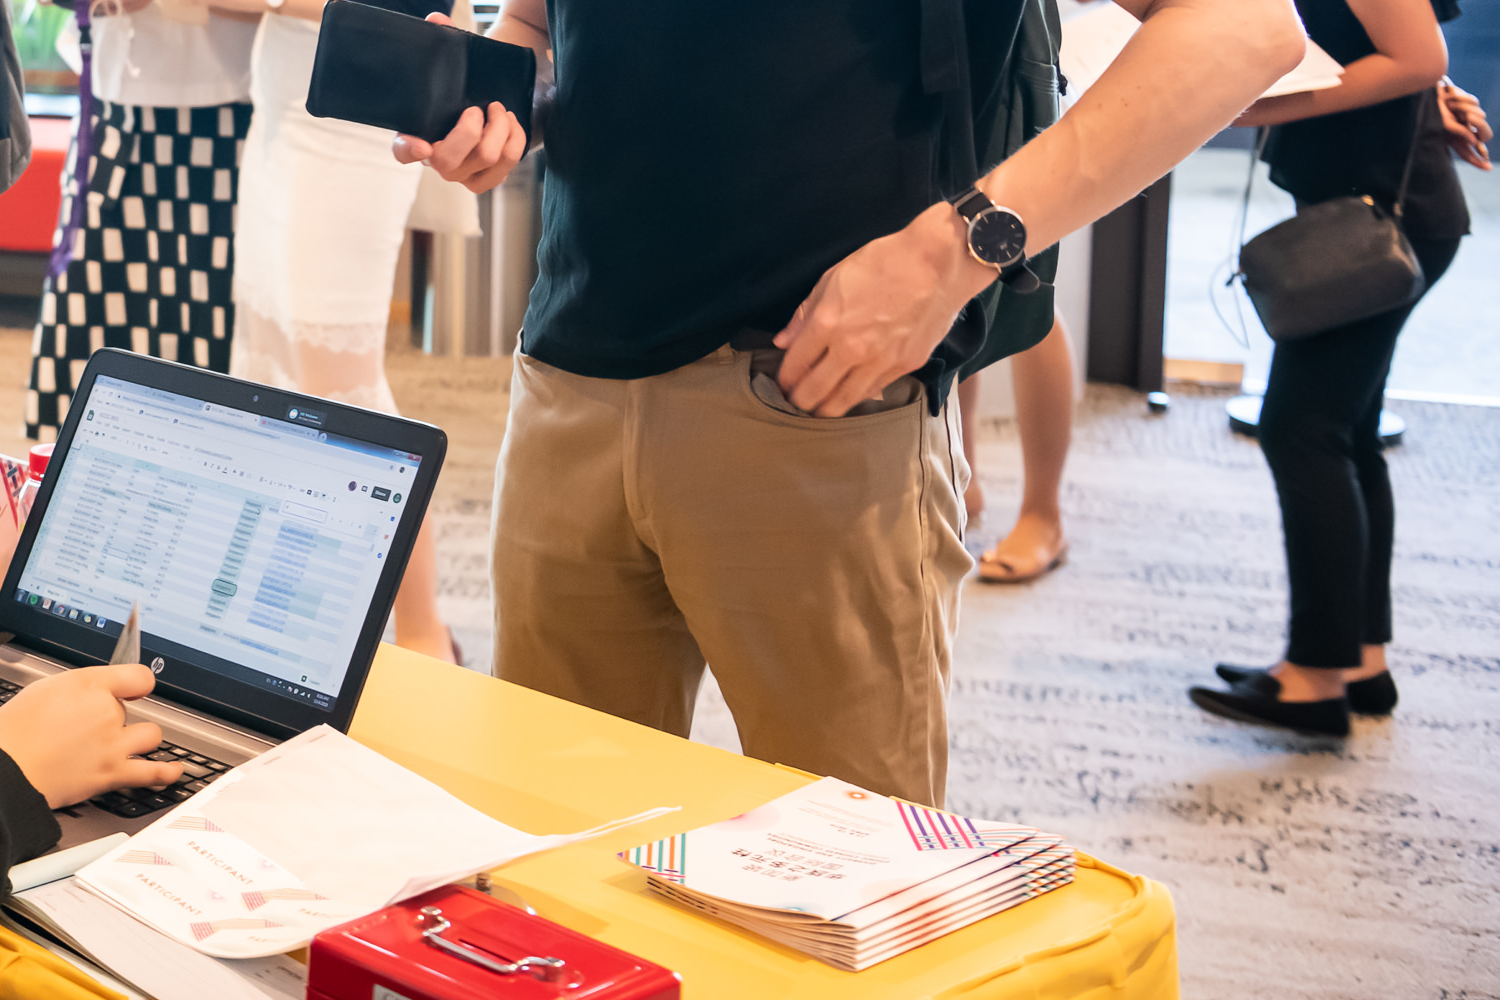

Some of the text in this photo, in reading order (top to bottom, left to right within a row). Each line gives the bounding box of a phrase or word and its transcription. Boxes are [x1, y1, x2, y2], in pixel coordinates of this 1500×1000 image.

[151, 657, 165, 674] hp
[186, 840, 253, 885] PARTICIPANT
[135, 873, 202, 916] PARTICIPANT
